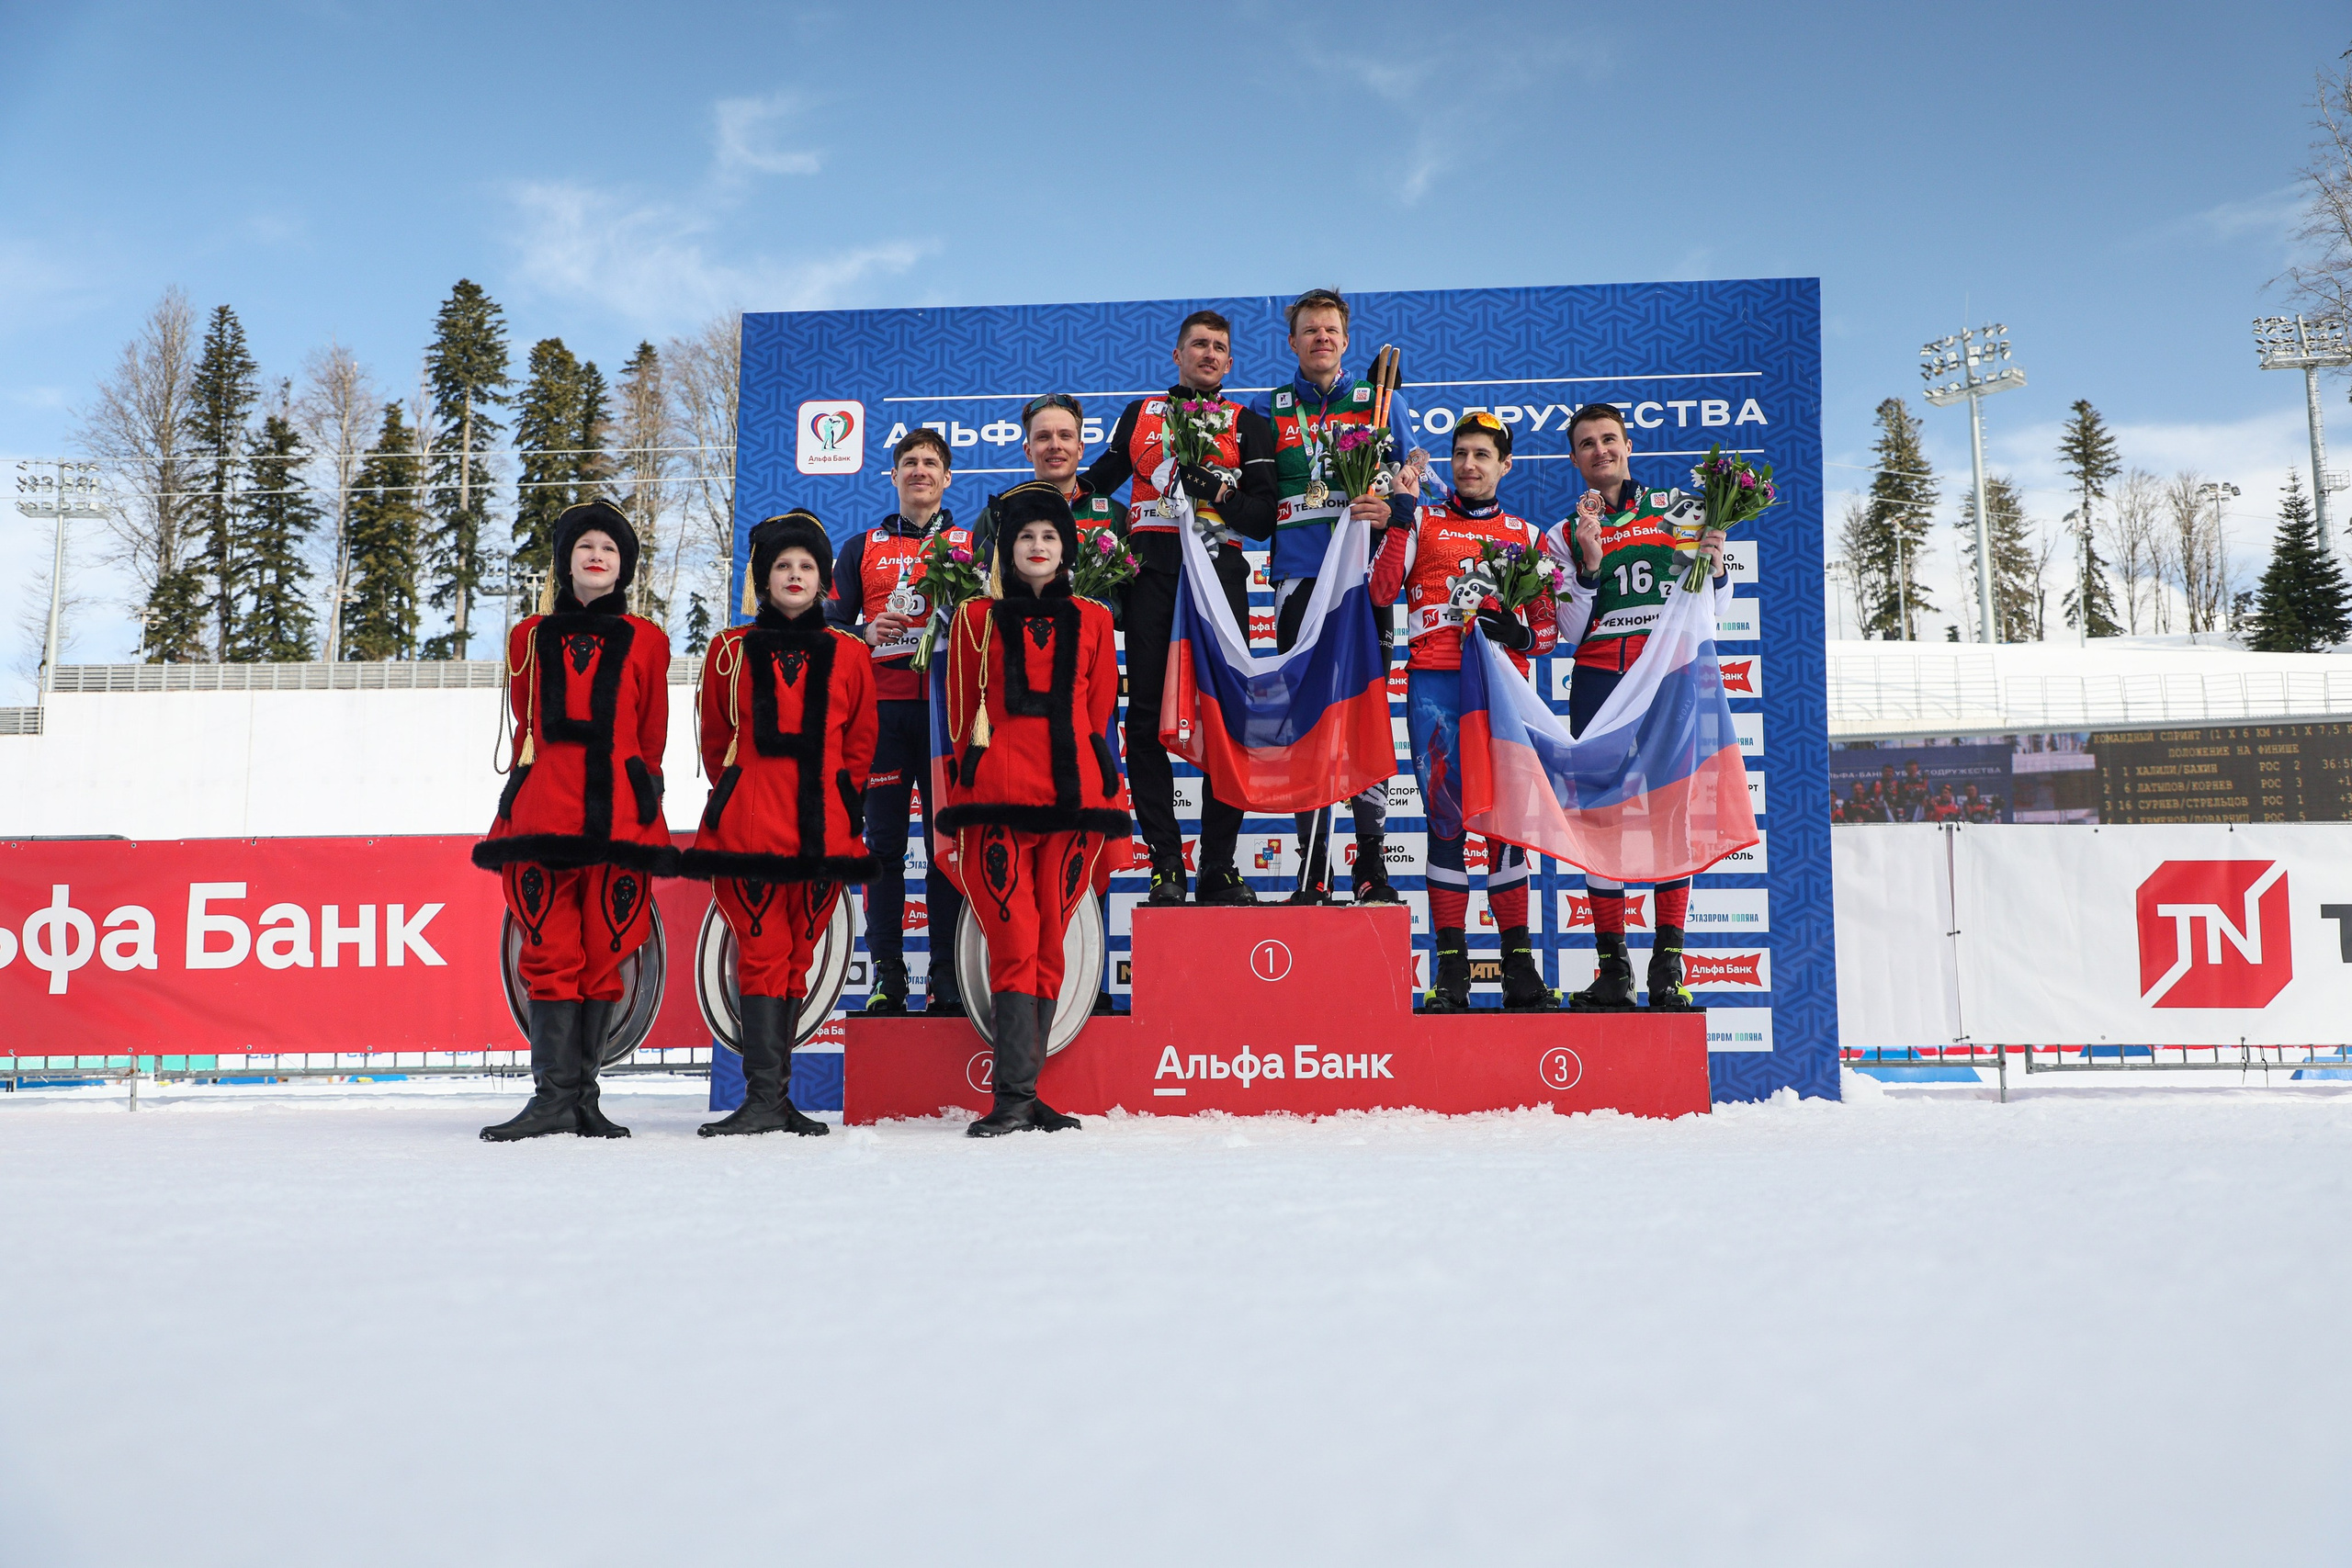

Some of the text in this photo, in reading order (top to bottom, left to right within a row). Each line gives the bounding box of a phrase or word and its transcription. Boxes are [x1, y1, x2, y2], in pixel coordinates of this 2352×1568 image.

[808, 455, 831, 463] Альфа
[1440, 529, 1485, 541] Альфа
[1601, 527, 1632, 544] льфа
[1613, 559, 1654, 596] 16
[1410, 584, 1423, 603] 16
[1664, 584, 1672, 595] 2
[1723, 622, 1750, 631] ПОЛЯНА
[1388, 677, 1407, 685] анк
[1720, 671, 1744, 681] Банк
[2160, 730, 2201, 741] СПРИНТ
[2243, 728, 2249, 738] 6
[2256, 728, 2270, 738] КМ
[2290, 727, 2297, 736] 1
[2168, 744, 2300, 758] ПОЛОЖЕНИЕ НА ФИНИШЕ
[2102, 767, 2109, 777] 1
[2122, 766, 2129, 777] 1
[2258, 761, 2280, 772] РОС
[2293, 760, 2301, 770] 2
[2103, 784, 2110, 795] 2
[2123, 783, 2131, 793] 6
[2261, 778, 2281, 789] РОС
[2295, 777, 2302, 787] 3
[2105, 800, 2112, 811] 3
[2118, 800, 2132, 811] 16
[2262, 795, 2284, 807] РОС
[2297, 795, 2303, 805] 1
[1695, 913, 1759, 922] ГАЗПРОМ ПОЛЯНА
[186, 882, 447, 970] Банк
[1264, 947, 1274, 974] 1
[1691, 964, 1753, 975] Альфа Банк
[1736, 1032, 1763, 1042] ПОЛЯНА
[981, 1058, 993, 1085] 2
[1154, 1044, 1395, 1089] Альфа Банк
[1555, 1054, 1567, 1081] 3
